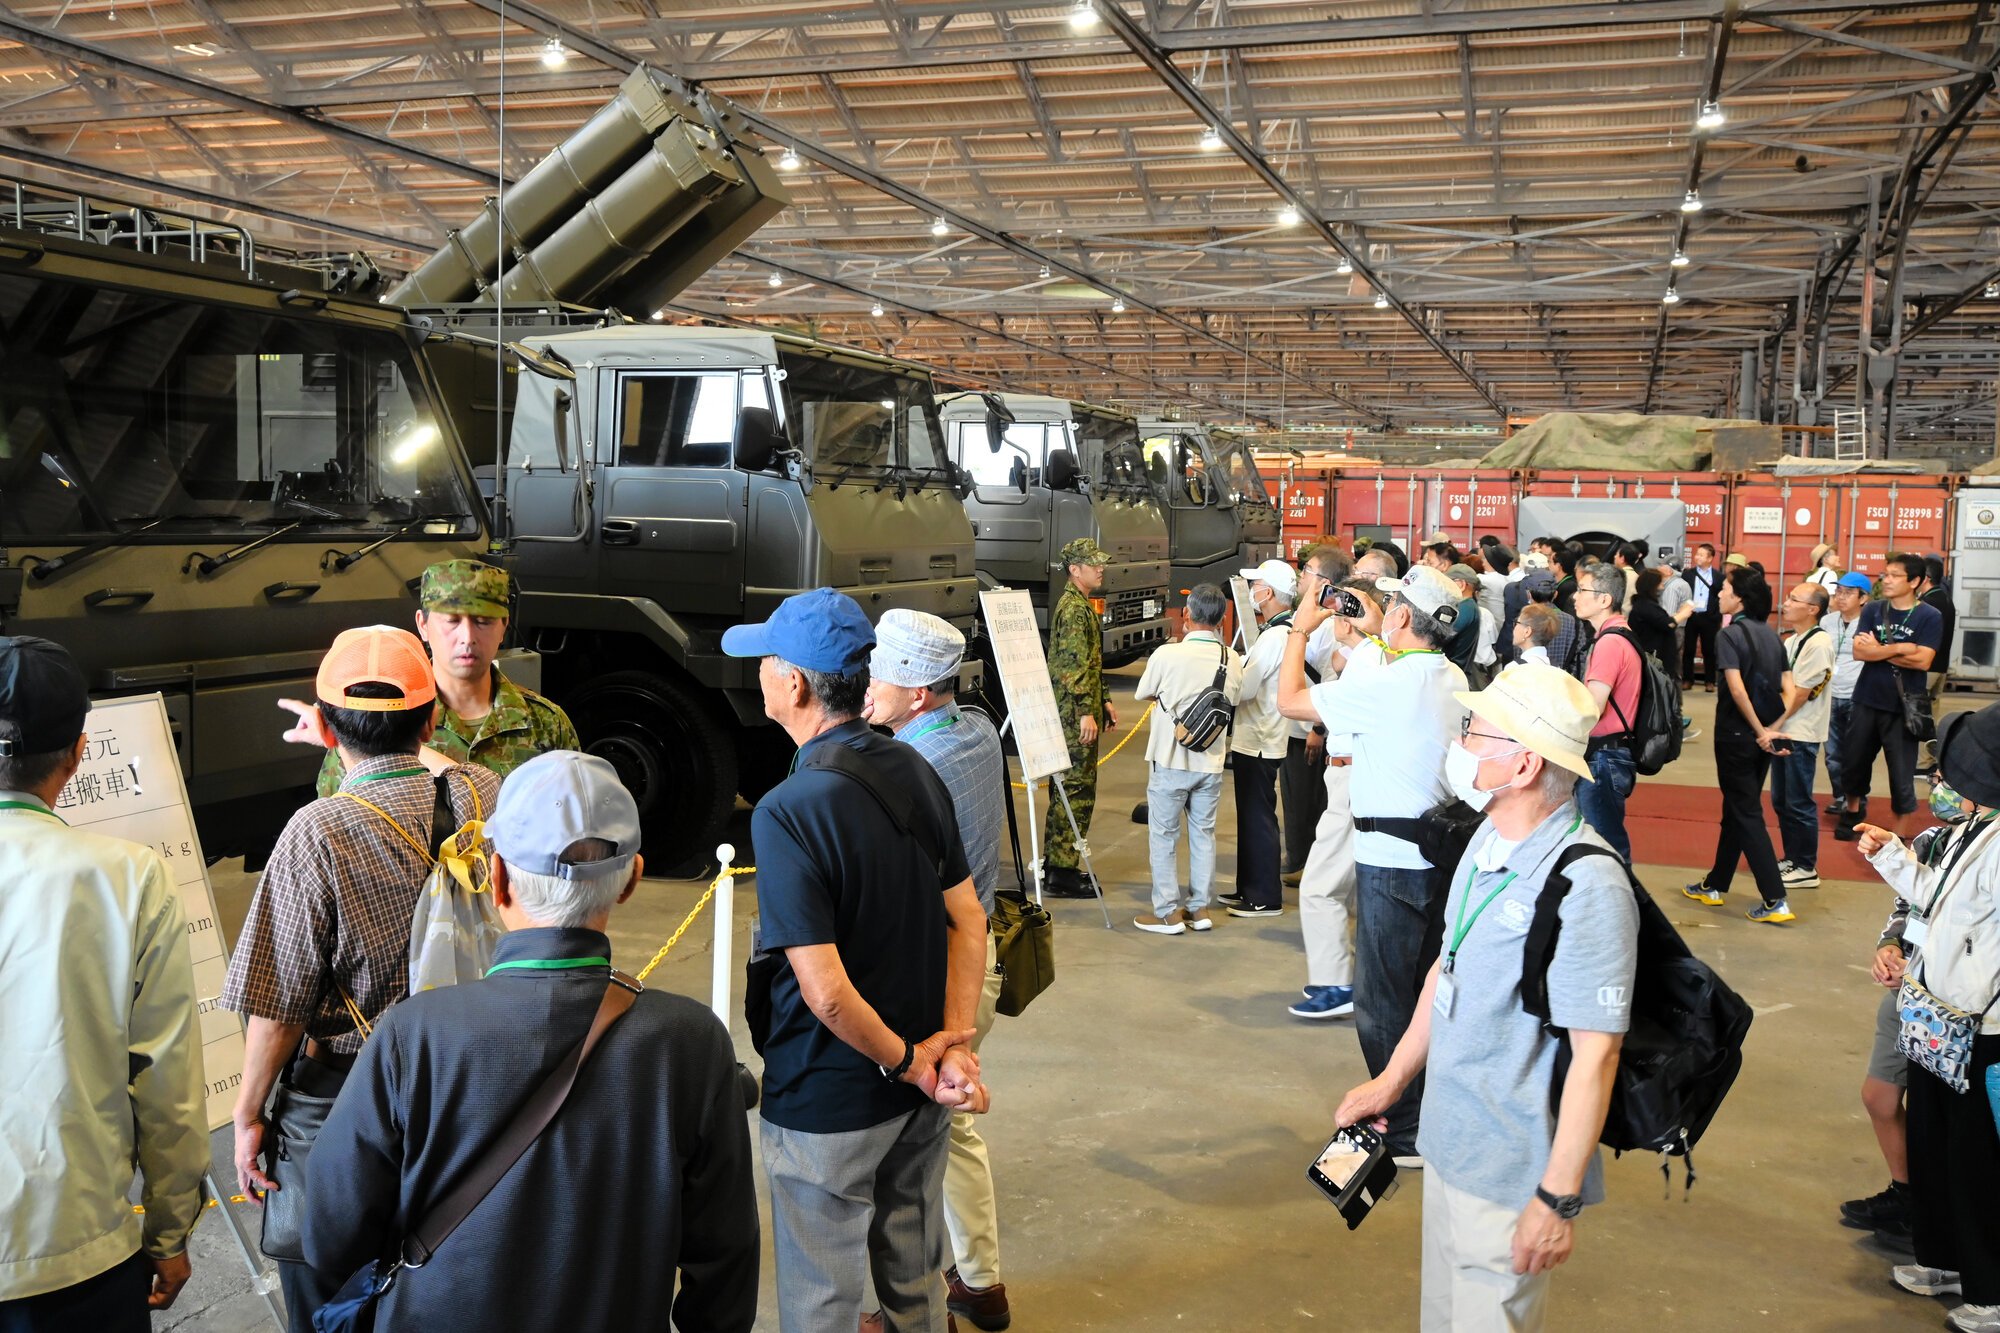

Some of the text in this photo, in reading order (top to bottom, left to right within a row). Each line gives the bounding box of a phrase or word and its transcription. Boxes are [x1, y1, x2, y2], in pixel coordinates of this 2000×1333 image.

[1449, 495, 1469, 505] FSCU
[1477, 496, 1506, 505] 767073
[1685, 504, 1710, 514] 38435
[1867, 507, 1888, 517] FSCU
[1898, 507, 1932, 518] 328998
